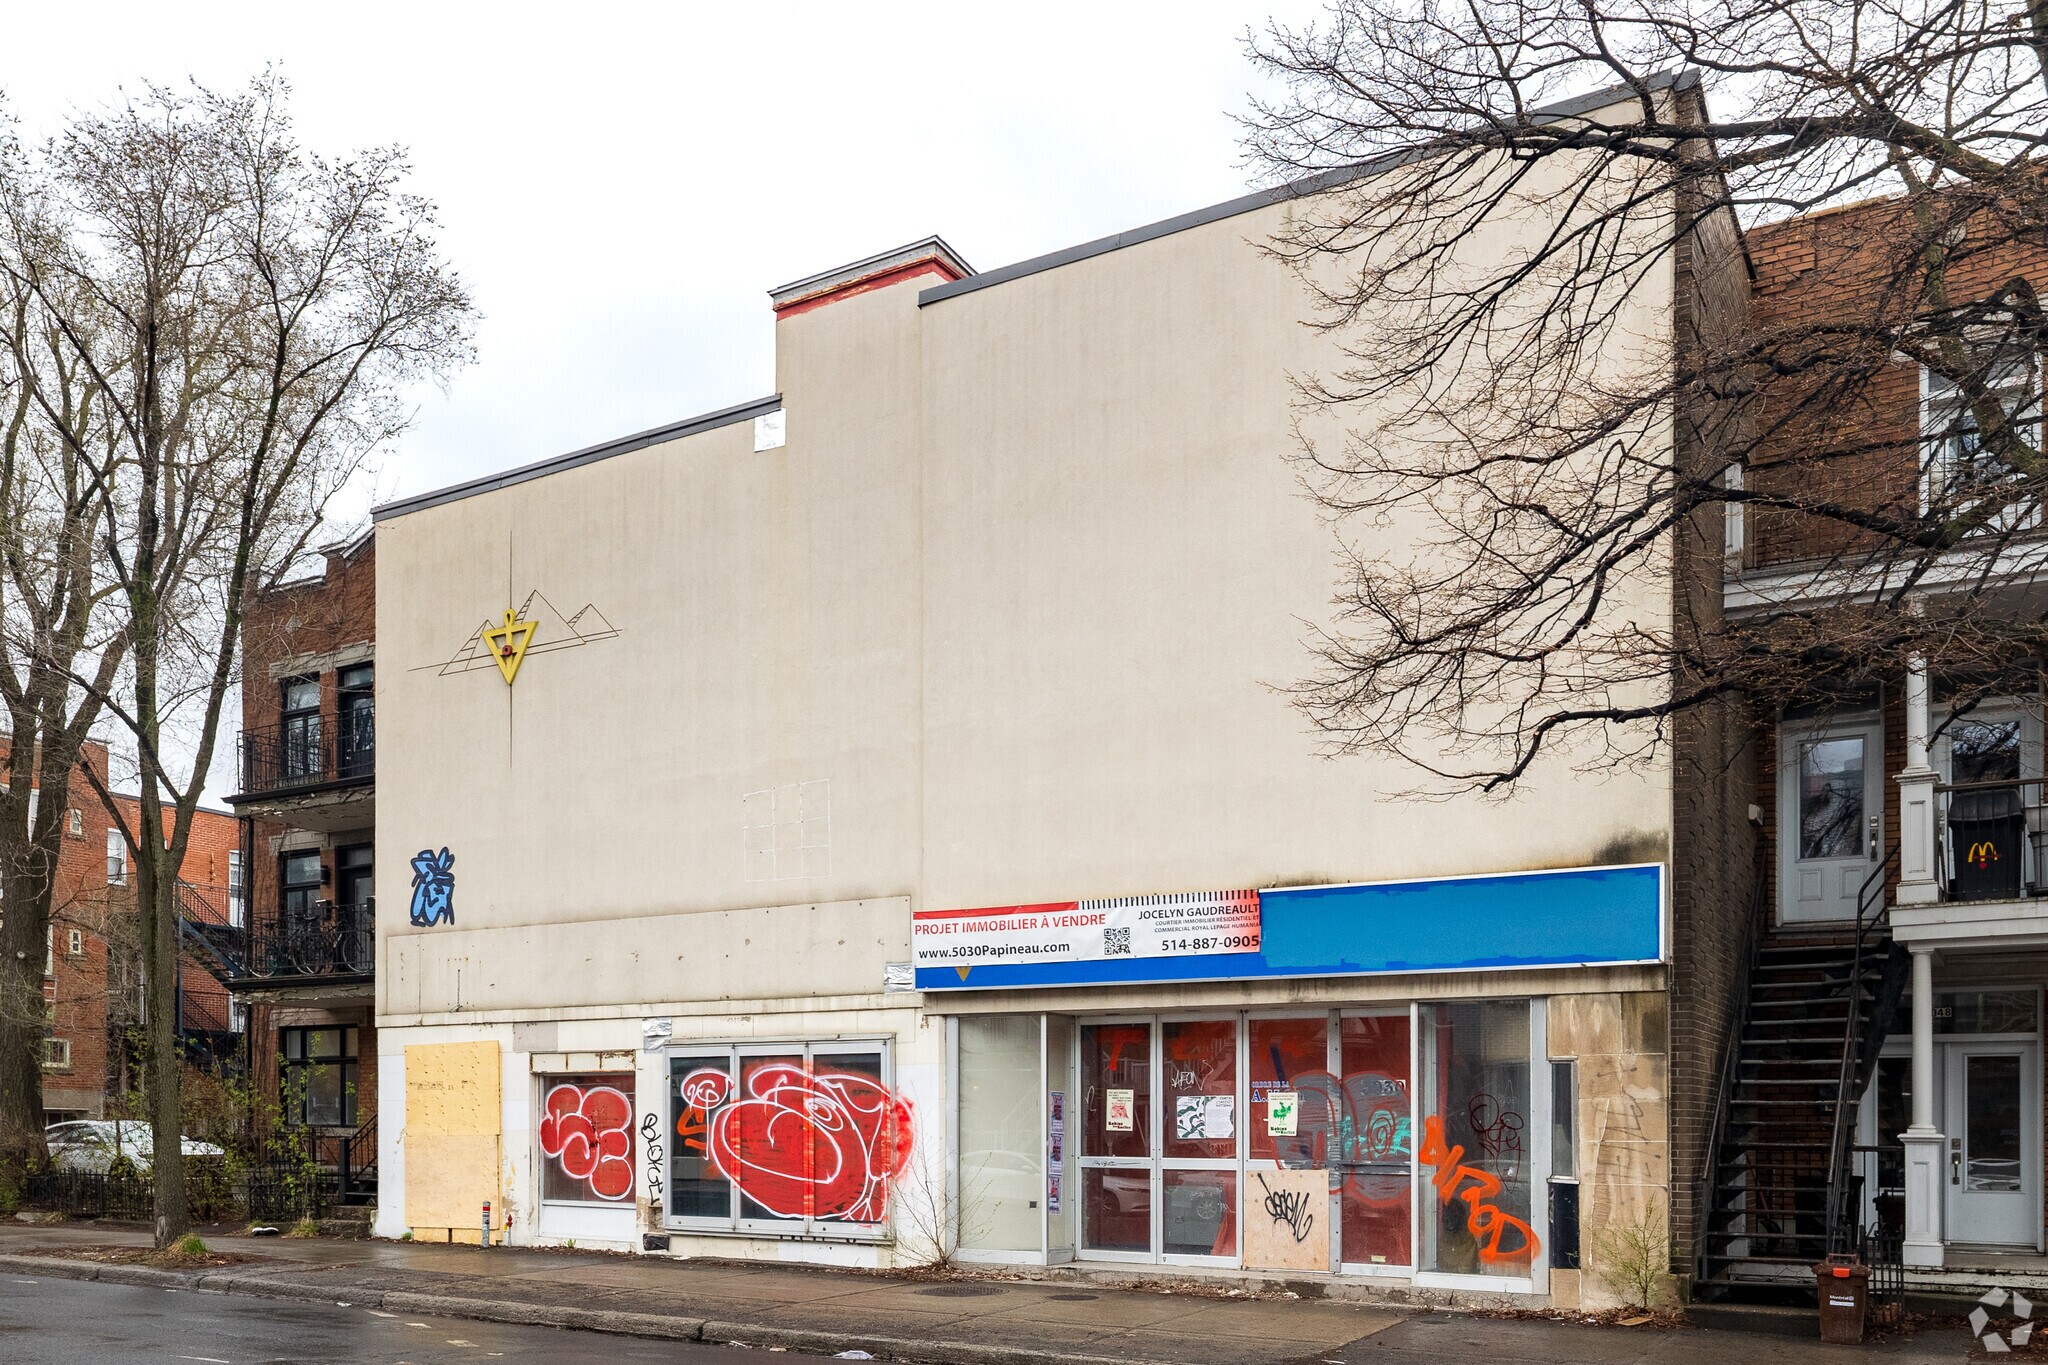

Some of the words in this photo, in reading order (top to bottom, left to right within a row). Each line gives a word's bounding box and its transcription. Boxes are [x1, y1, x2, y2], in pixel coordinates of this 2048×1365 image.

[1138, 908, 1184, 920] JOCELYN
[1187, 903, 1260, 917] GAUDREAULT
[915, 923, 959, 935] PROJET
[962, 918, 1038, 933] IMMOBILIER
[1041, 915, 1050, 928] À
[1053, 913, 1106, 928] VENDRE
[1182, 917, 1216, 925] IMMOBILIER
[1210, 923, 1231, 931] LEPAGE
[918, 943, 1070, 959] www.5030Papineau.com
[1161, 935, 1260, 951] 514-887-0905
